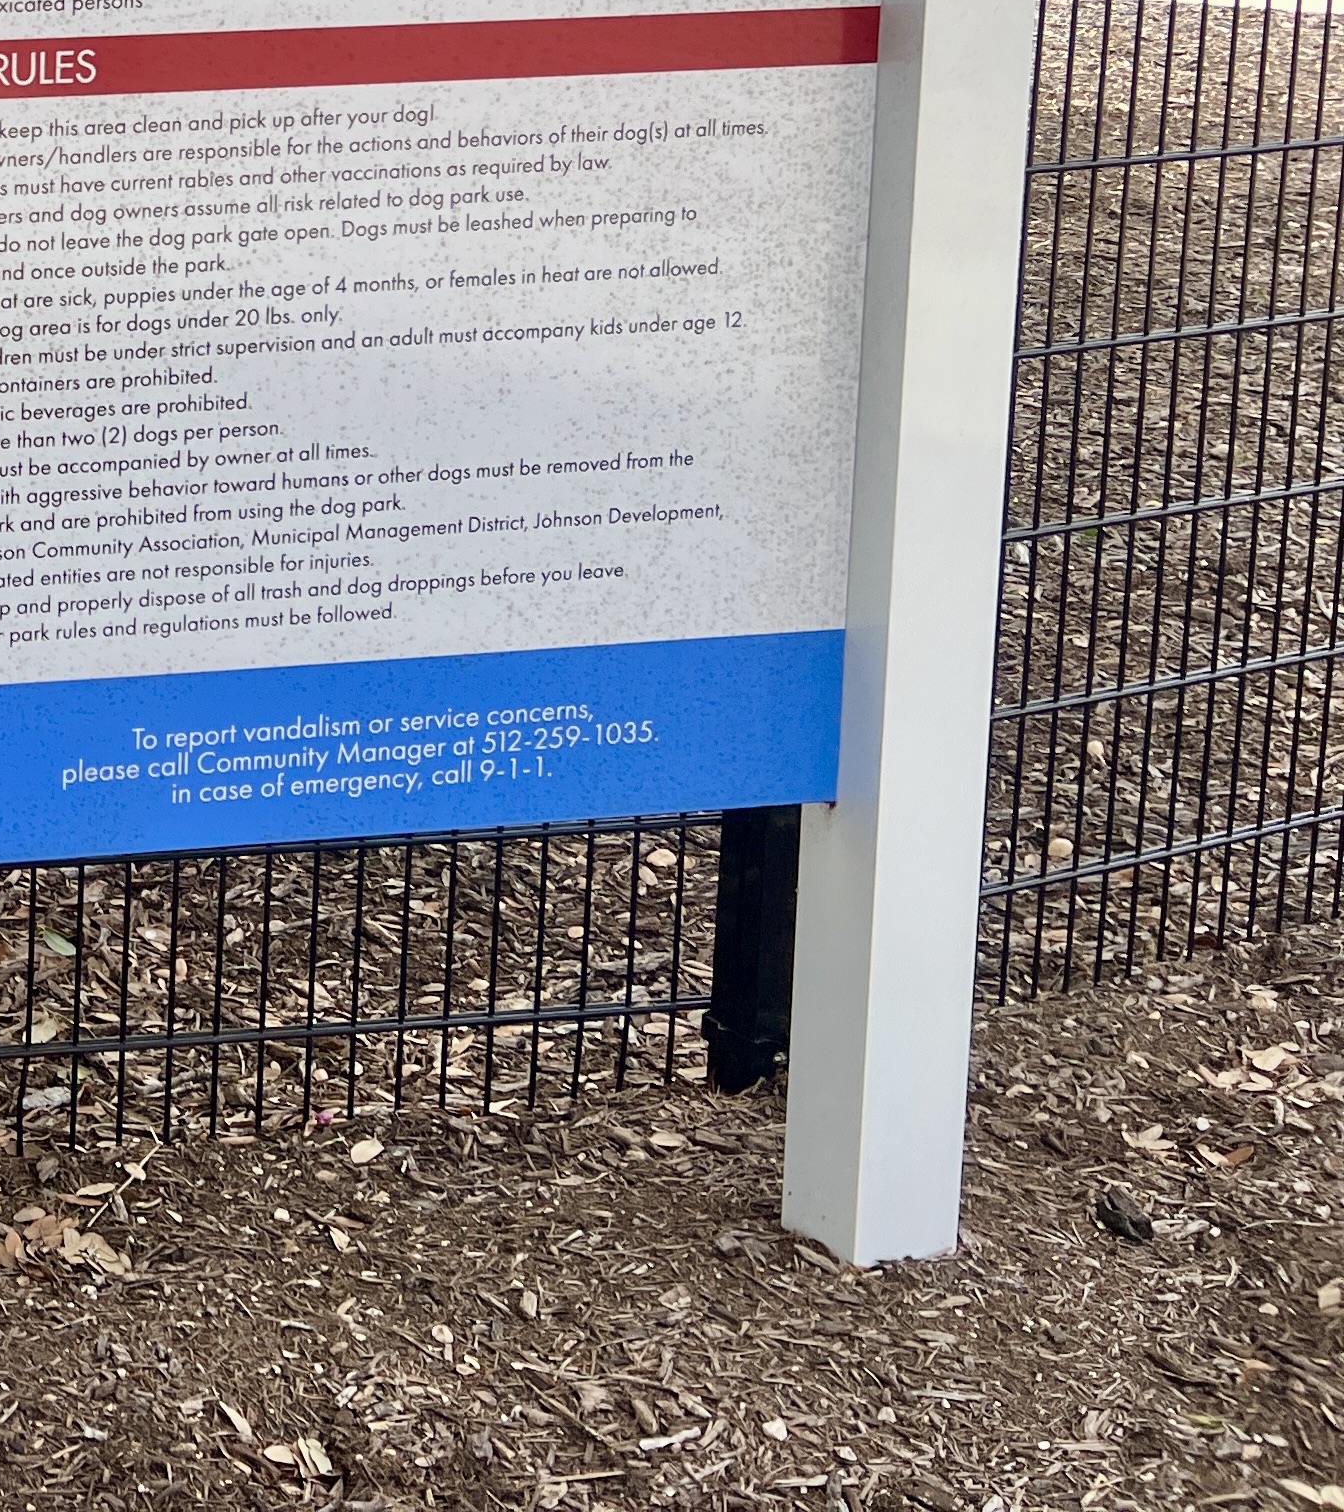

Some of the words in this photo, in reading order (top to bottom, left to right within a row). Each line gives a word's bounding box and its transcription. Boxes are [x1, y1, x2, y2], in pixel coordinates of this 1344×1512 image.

[85, 376, 115, 389] are
[120, 364, 217, 393] prohibited.
[16, 429, 55, 449] than
[61, 431, 95, 446] two
[101, 424, 127, 448] (2)
[132, 423, 178, 447] dogs
[183, 426, 214, 445] per
[26, 483, 122, 508] aggressive
[128, 478, 208, 498] behavior
[212, 471, 276, 493] toward
[281, 471, 349, 490] humans
[353, 473, 373, 486] or
[377, 464, 424, 484] other
[427, 462, 471, 485] dogs
[475, 461, 514, 478] must
[519, 457, 541, 476] be
[546, 451, 621, 474] removed
[626, 450, 663, 469] from
[668, 448, 694, 467] the
[28, 456, 51, 476] be
[56, 449, 181, 476] accompanied
[186, 448, 209, 472] by
[214, 451, 272, 466] owner
[276, 447, 294, 463] at
[298, 441, 319, 462] all
[325, 445, 374, 460] times.
[19, 511, 55, 532] and
[61, 516, 90, 530] are
[96, 503, 187, 533] prohibited
[193, 503, 232, 522] from
[237, 502, 283, 523] using
[289, 497, 315, 516] the
[320, 495, 356, 519] dog
[31, 538, 133, 559] Community
[137, 532, 244, 552] Association,
[251, 522, 339, 548] Municipal
[345, 518, 463, 543] Management
[467, 515, 528, 533] District,
[532, 509, 602, 529] Johnson
[608, 502, 723, 525] Development,
[39, 567, 101, 586] entities
[106, 568, 135, 582] are
[141, 563, 169, 580] not
[174, 554, 274, 581] responsible
[279, 552, 305, 571] for
[8, 622, 50, 648] park
[55, 619, 96, 640] rules
[102, 616, 136, 637] and
[142, 613, 239, 638] regulations
[244, 611, 284, 628] must
[289, 606, 311, 625] be
[131, 727, 157, 749] To
[165, 724, 237, 753] report
[242, 713, 360, 742] vandalism
[368, 717, 393, 733] or
[399, 707, 479, 731] service
[486, 703, 593, 725] concerns,
[62, 757, 140, 790] please
[147, 750, 188, 777] call
[196, 745, 329, 774] Community
[336, 741, 446, 765] Manager
[452, 735, 475, 756] at
[481, 719, 658, 754] 512-259-1035.
[171, 783, 191, 803] in
[198, 783, 252, 802] case
[260, 771, 284, 797] of
[290, 771, 423, 799] emergency,
[431, 762, 471, 785] call
[479, 755, 552, 781] 9-1-1.
